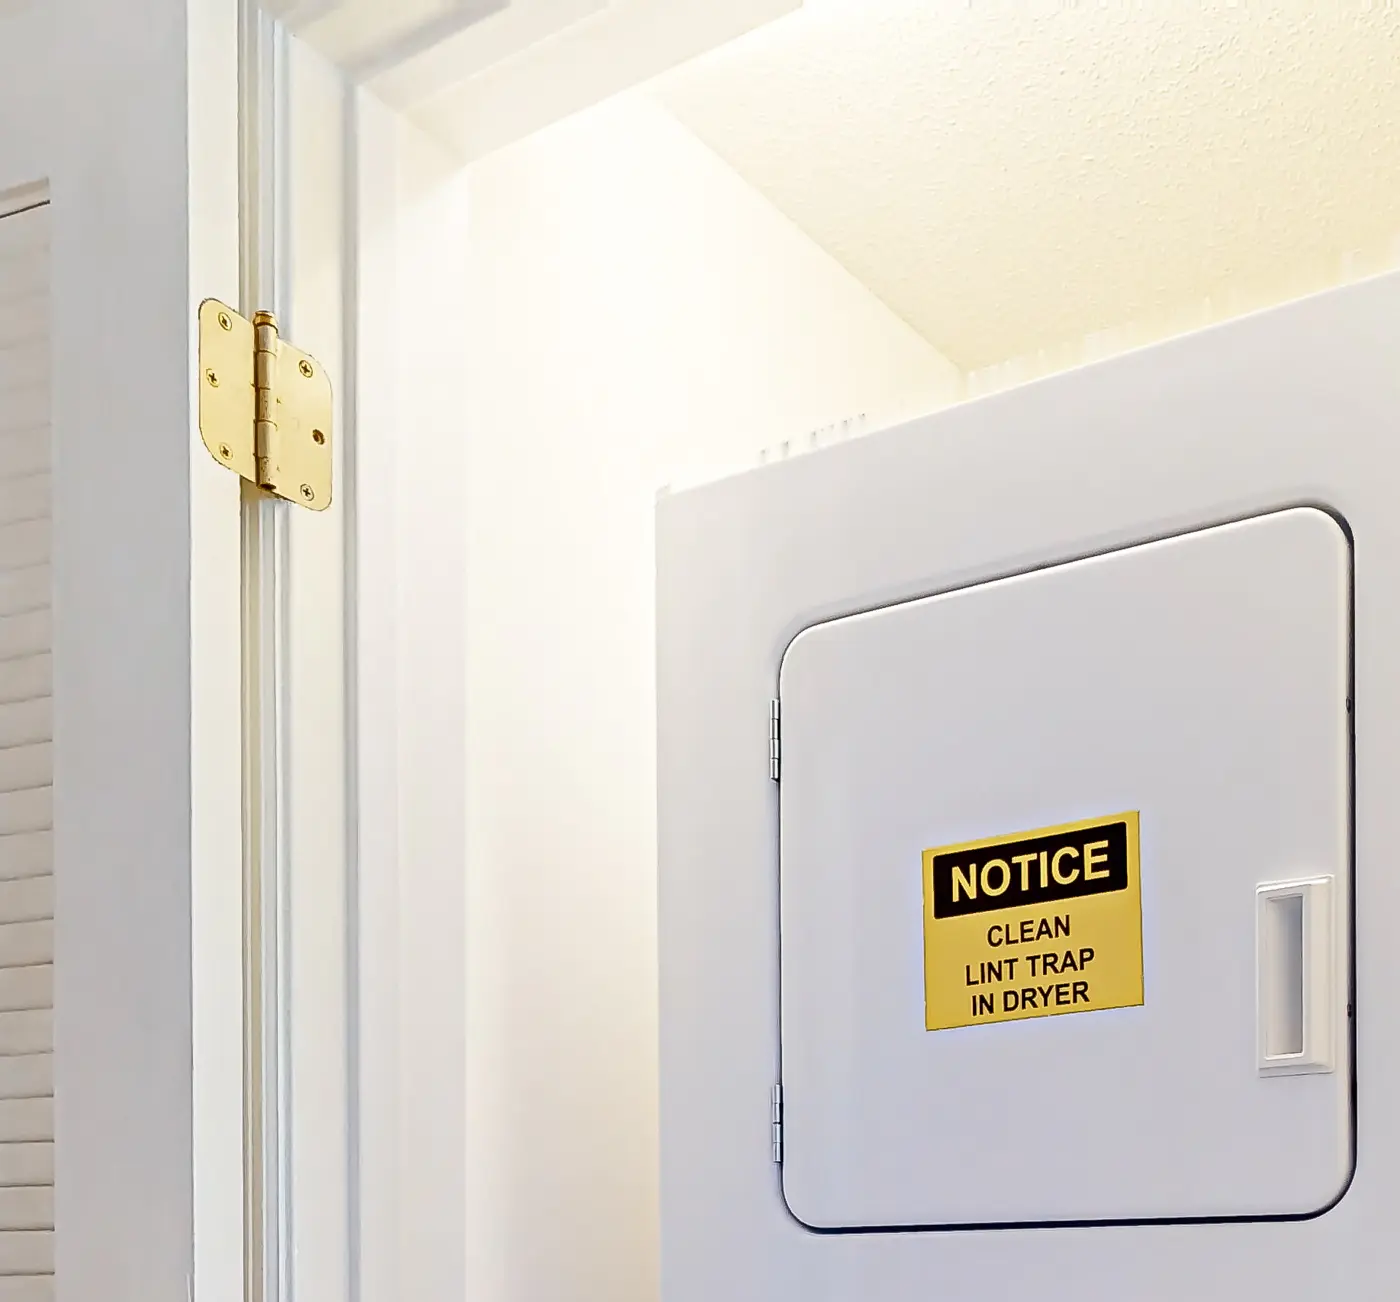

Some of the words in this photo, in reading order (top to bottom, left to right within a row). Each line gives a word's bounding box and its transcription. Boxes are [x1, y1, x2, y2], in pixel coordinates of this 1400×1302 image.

[952, 840, 1110, 902] NOTICE
[987, 915, 1070, 947] CLEAN
[966, 958, 1018, 986] LINT
[1026, 948, 1094, 977] TRAP
[972, 993, 994, 1016] IN
[1003, 981, 1090, 1012] DRYER
